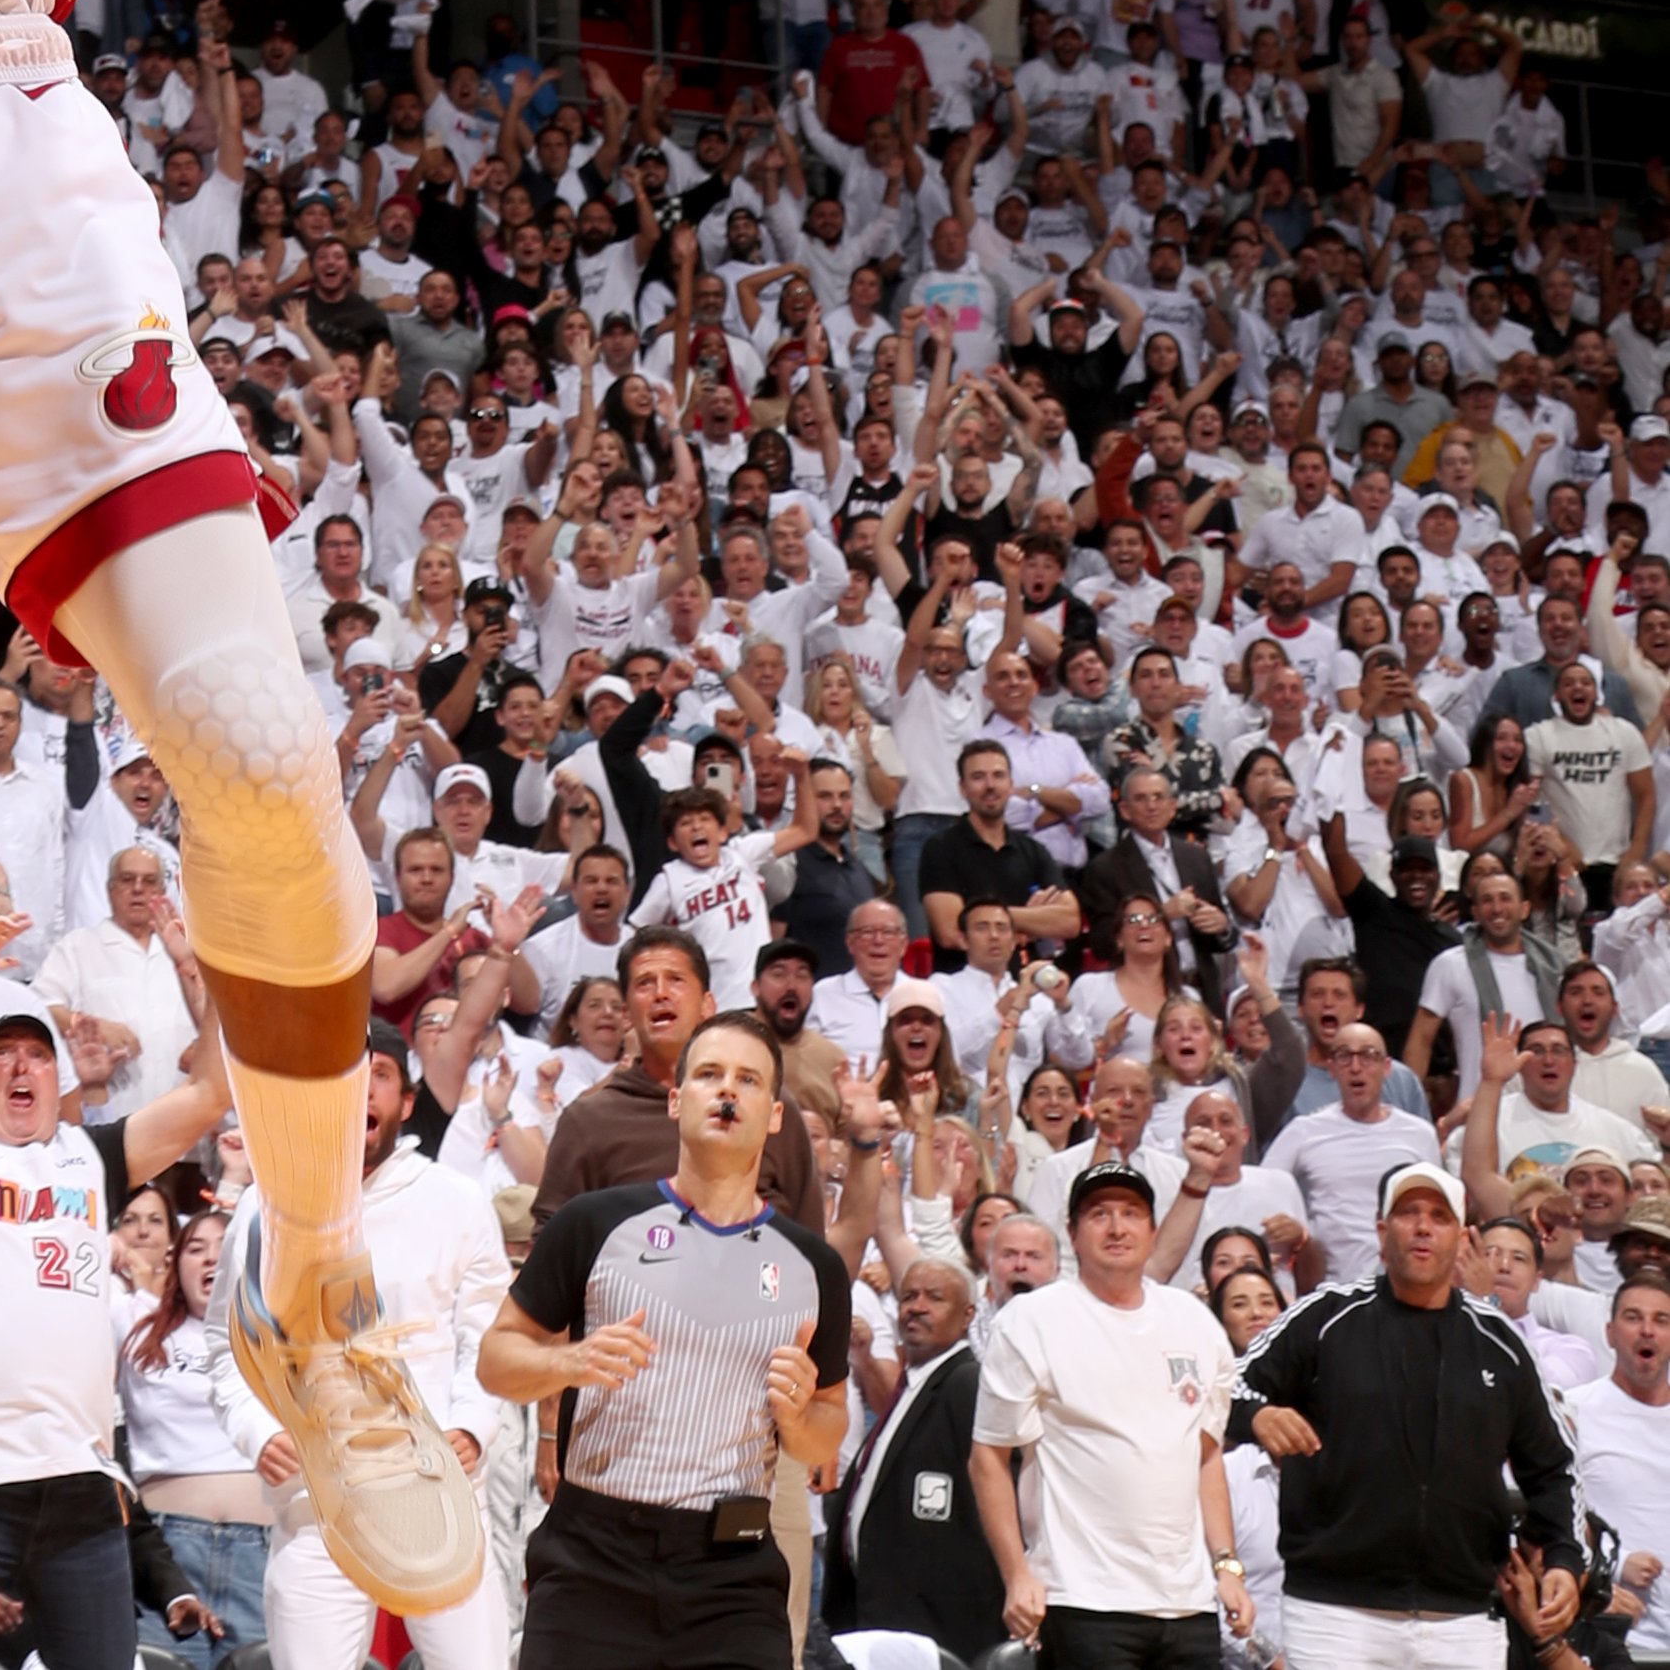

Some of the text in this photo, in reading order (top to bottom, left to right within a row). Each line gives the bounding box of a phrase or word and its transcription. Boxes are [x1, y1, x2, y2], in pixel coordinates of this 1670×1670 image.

[686, 871, 740, 922] HEAT
[725, 898, 752, 931] 14
[653, 1228, 670, 1249] TB
[32, 1237, 99, 1297] 22
